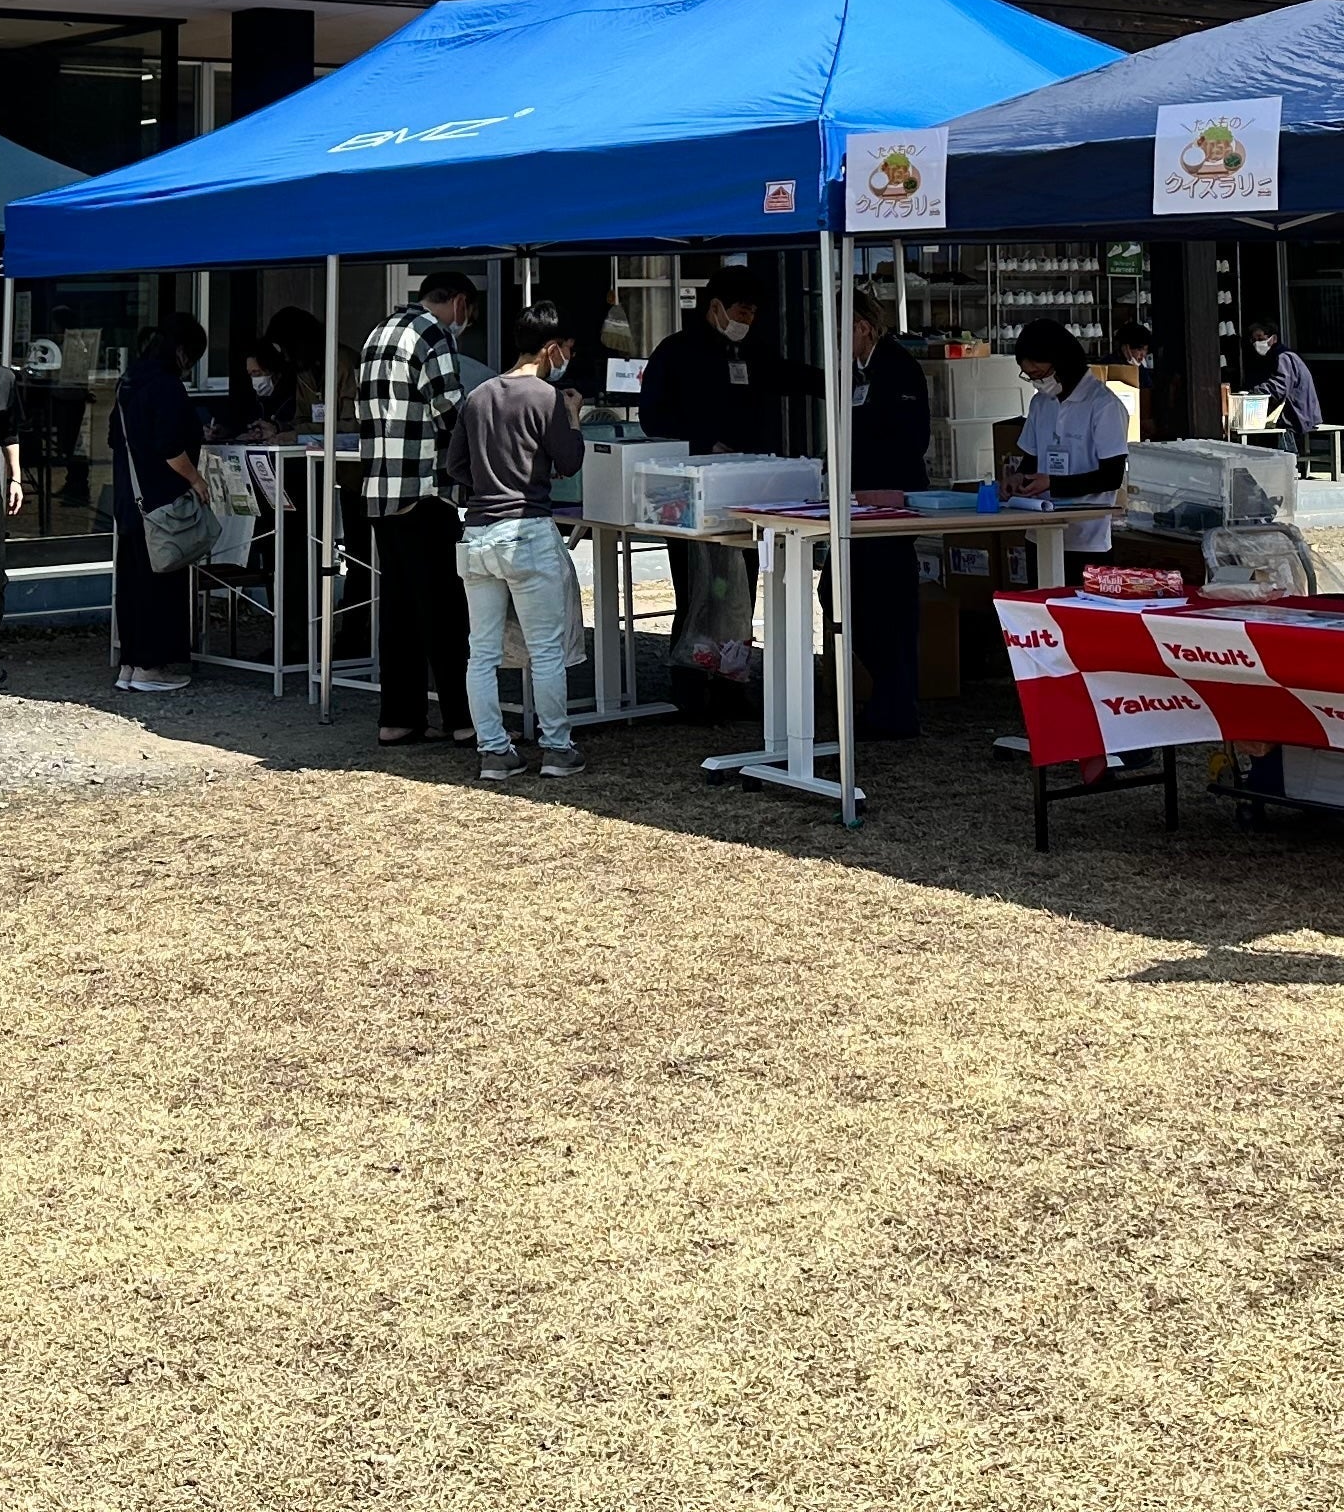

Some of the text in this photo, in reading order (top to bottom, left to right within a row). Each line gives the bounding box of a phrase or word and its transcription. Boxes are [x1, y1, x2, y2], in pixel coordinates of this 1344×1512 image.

[1099, 584, 1122, 594] 1000
[1162, 642, 1256, 668] Yakult
[1101, 695, 1201, 715] Yakult
